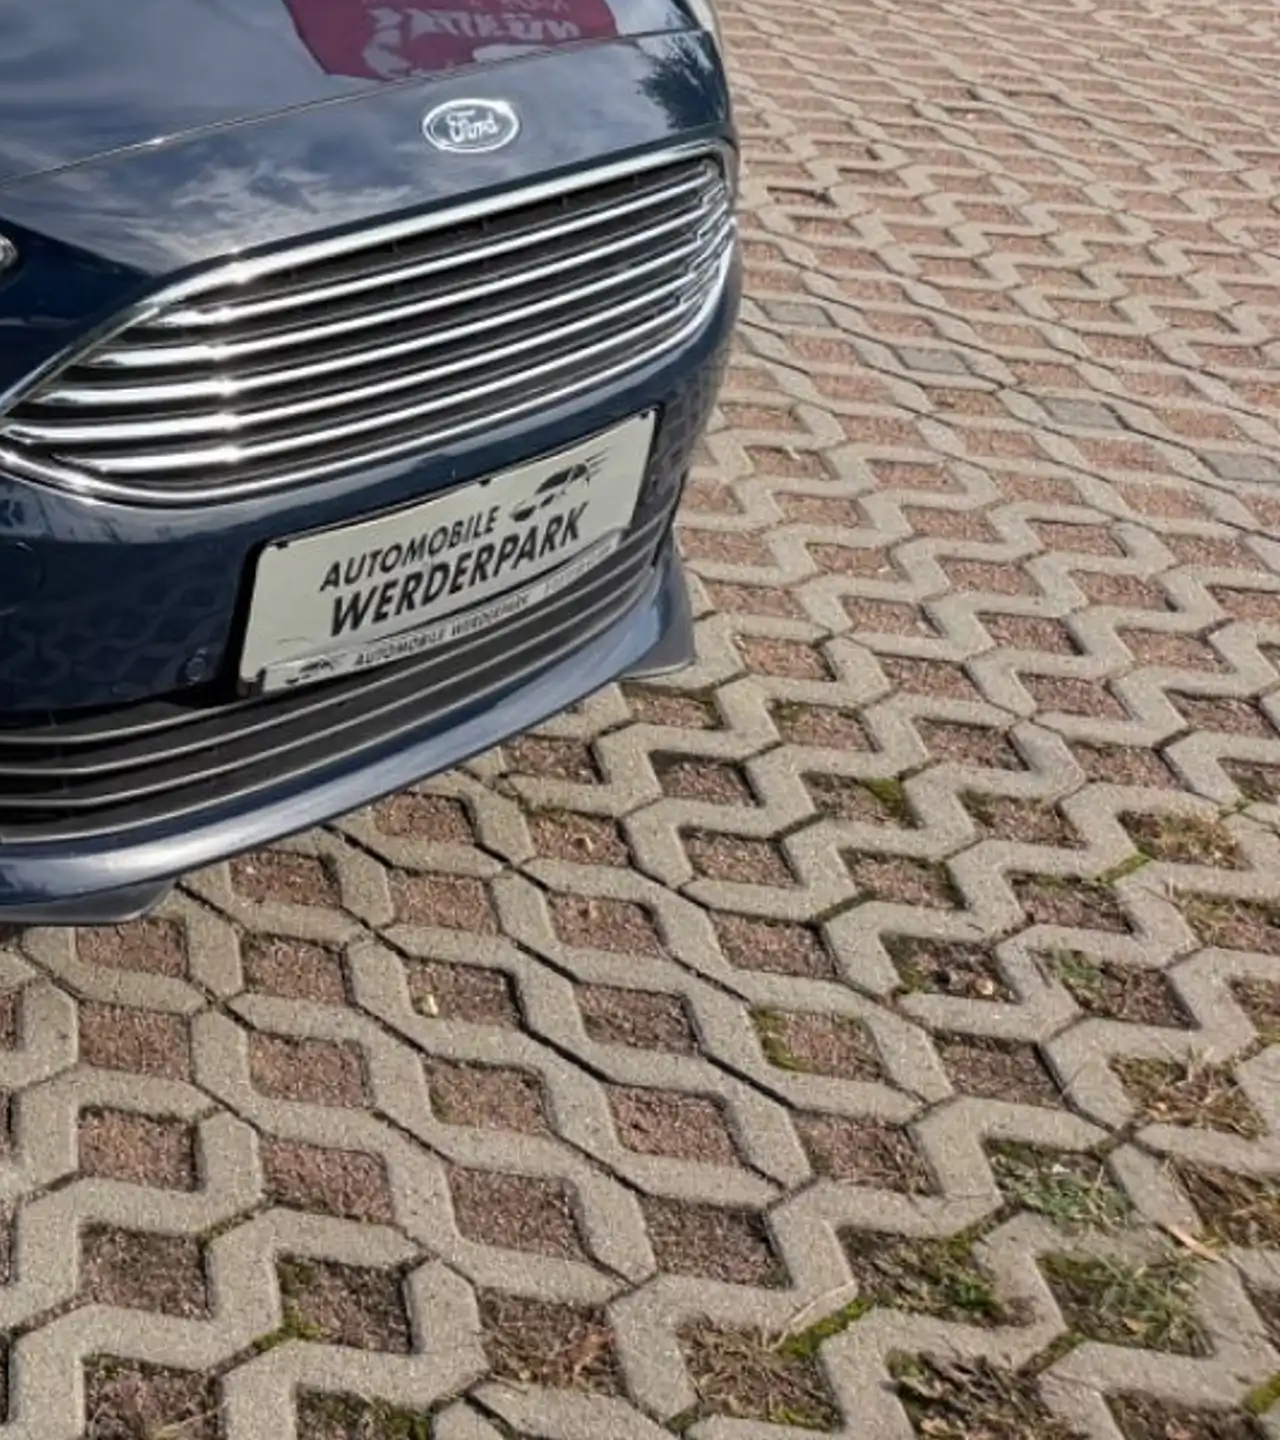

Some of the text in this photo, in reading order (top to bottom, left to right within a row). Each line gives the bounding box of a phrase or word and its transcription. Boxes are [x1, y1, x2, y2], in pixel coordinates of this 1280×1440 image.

[444, 109, 500, 143] Ford
[320, 505, 501, 591] AUTOMOBILE
[330, 502, 590, 637] WERDERPARK
